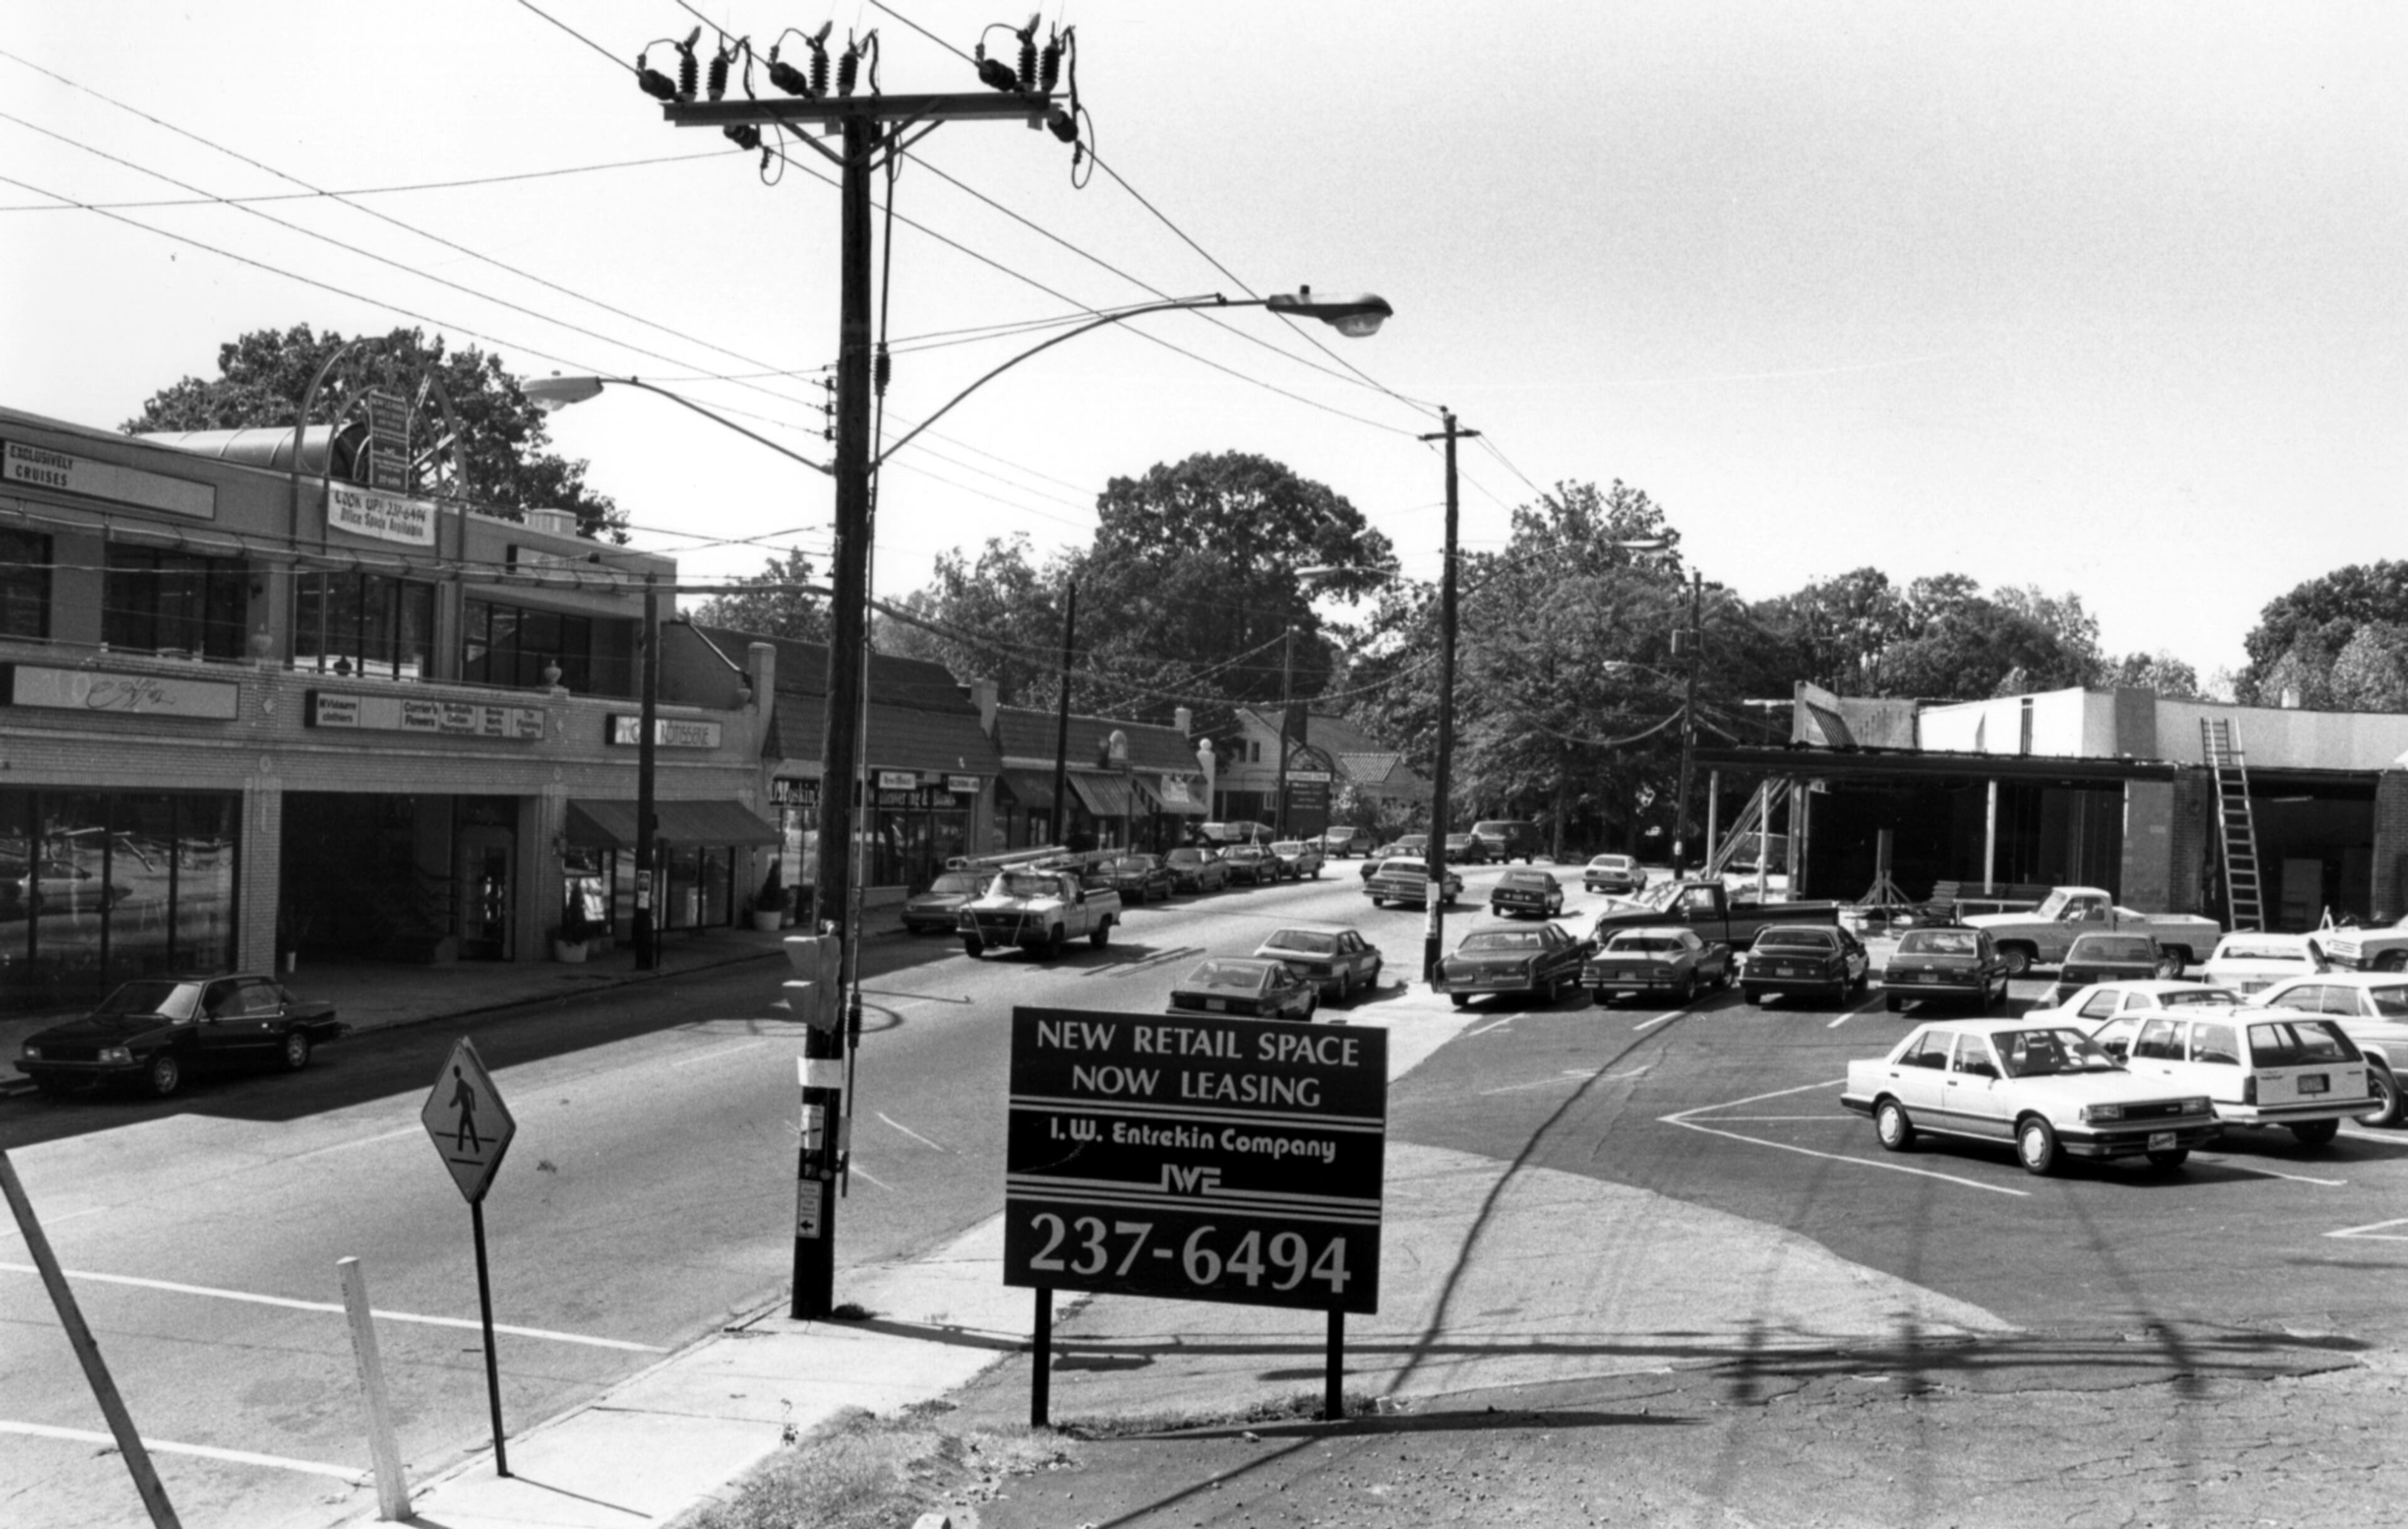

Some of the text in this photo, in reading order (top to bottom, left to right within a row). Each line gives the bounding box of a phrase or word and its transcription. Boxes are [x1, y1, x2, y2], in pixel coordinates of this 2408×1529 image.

[11, 445, 73, 470] EXCLUSIVELY
[16, 464, 68, 487] CRUISES
[335, 490, 361, 509] LOOK
[405, 714, 435, 727] Flowers
[1038, 1020, 1359, 1067] NEW RETAIL SPACE
[1073, 1065, 1320, 1107] NOW LEASING
[1112, 1122, 1214, 1150] Entrekin
[1220, 1128, 1336, 1164] Company
[1030, 1213, 1351, 1293] 237-6494
